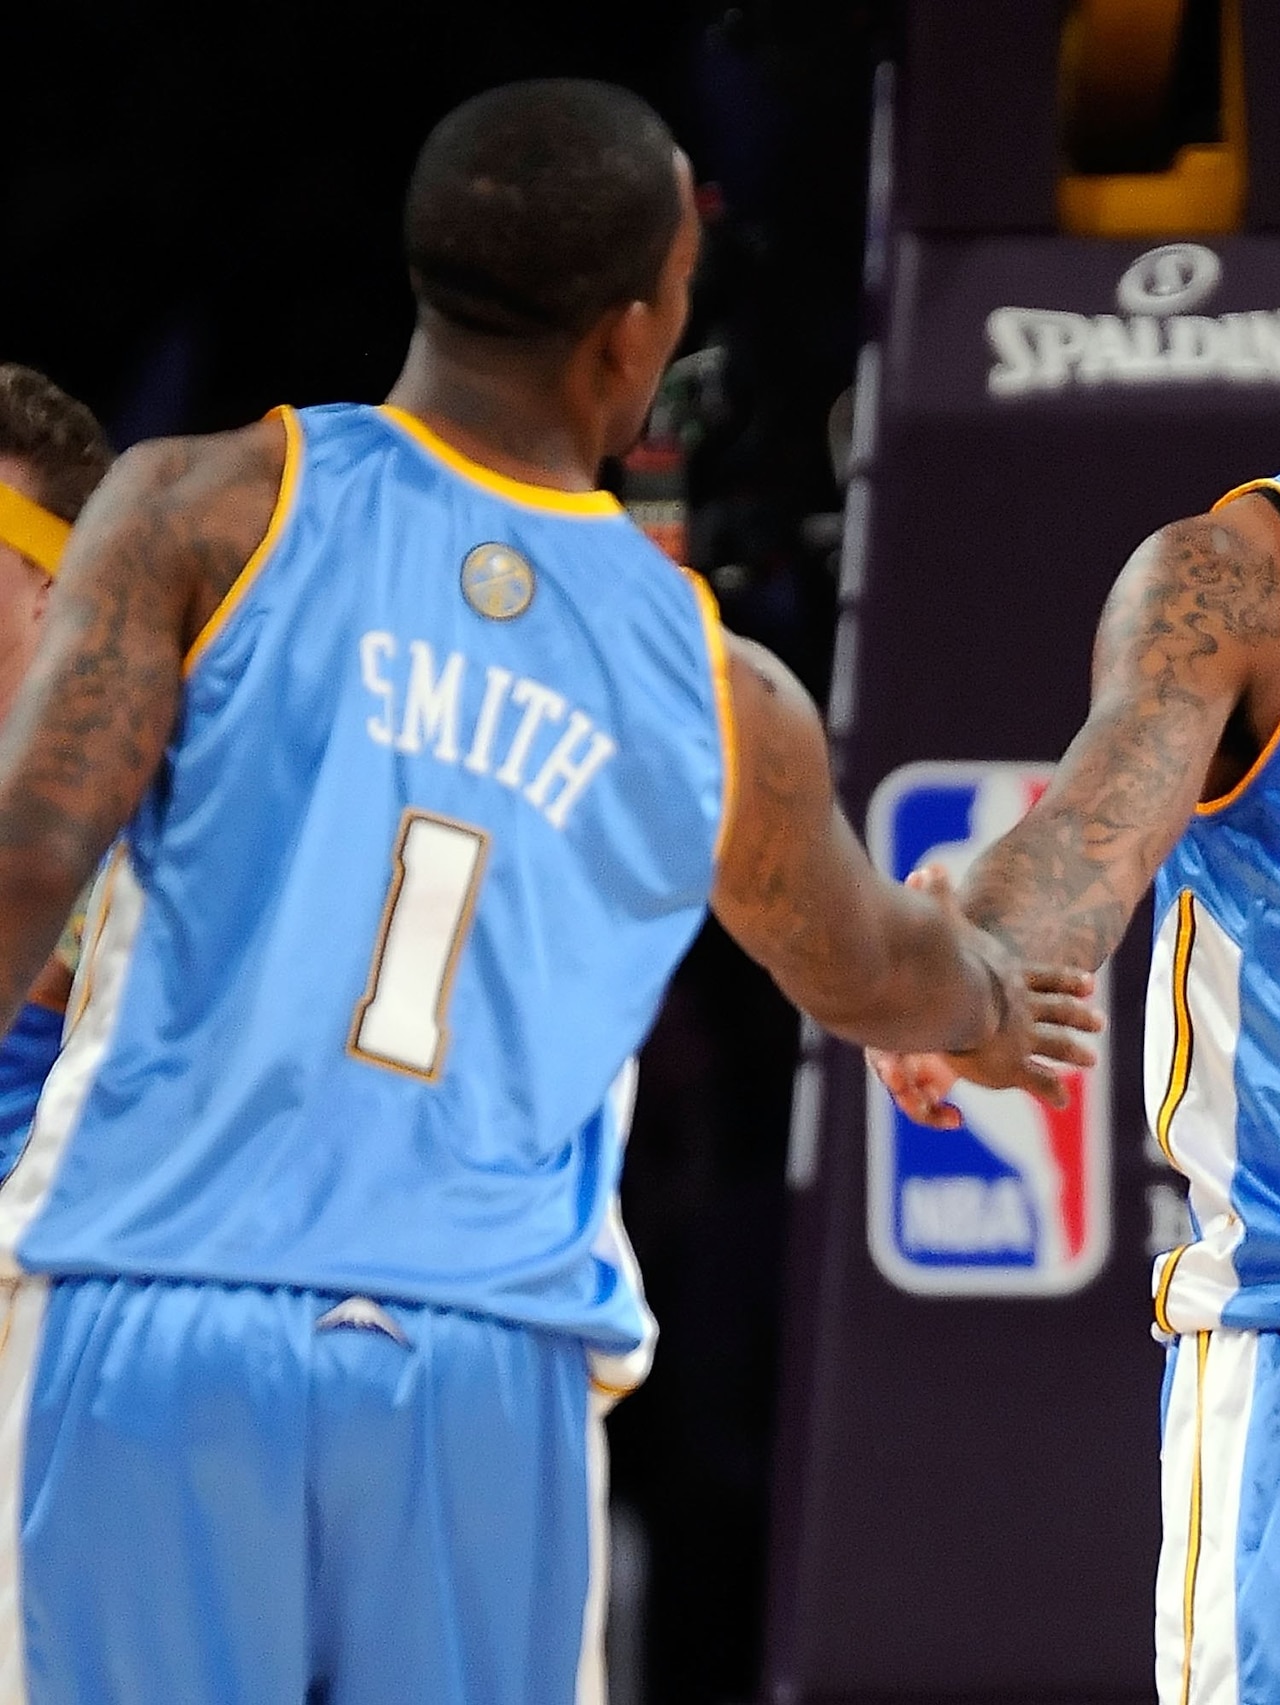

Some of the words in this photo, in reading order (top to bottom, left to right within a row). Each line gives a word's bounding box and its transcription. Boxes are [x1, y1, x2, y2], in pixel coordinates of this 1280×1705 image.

[359, 630, 617, 829] SMITH
[348, 809, 490, 1081] 1
[902, 1175, 1031, 1250] NBA
